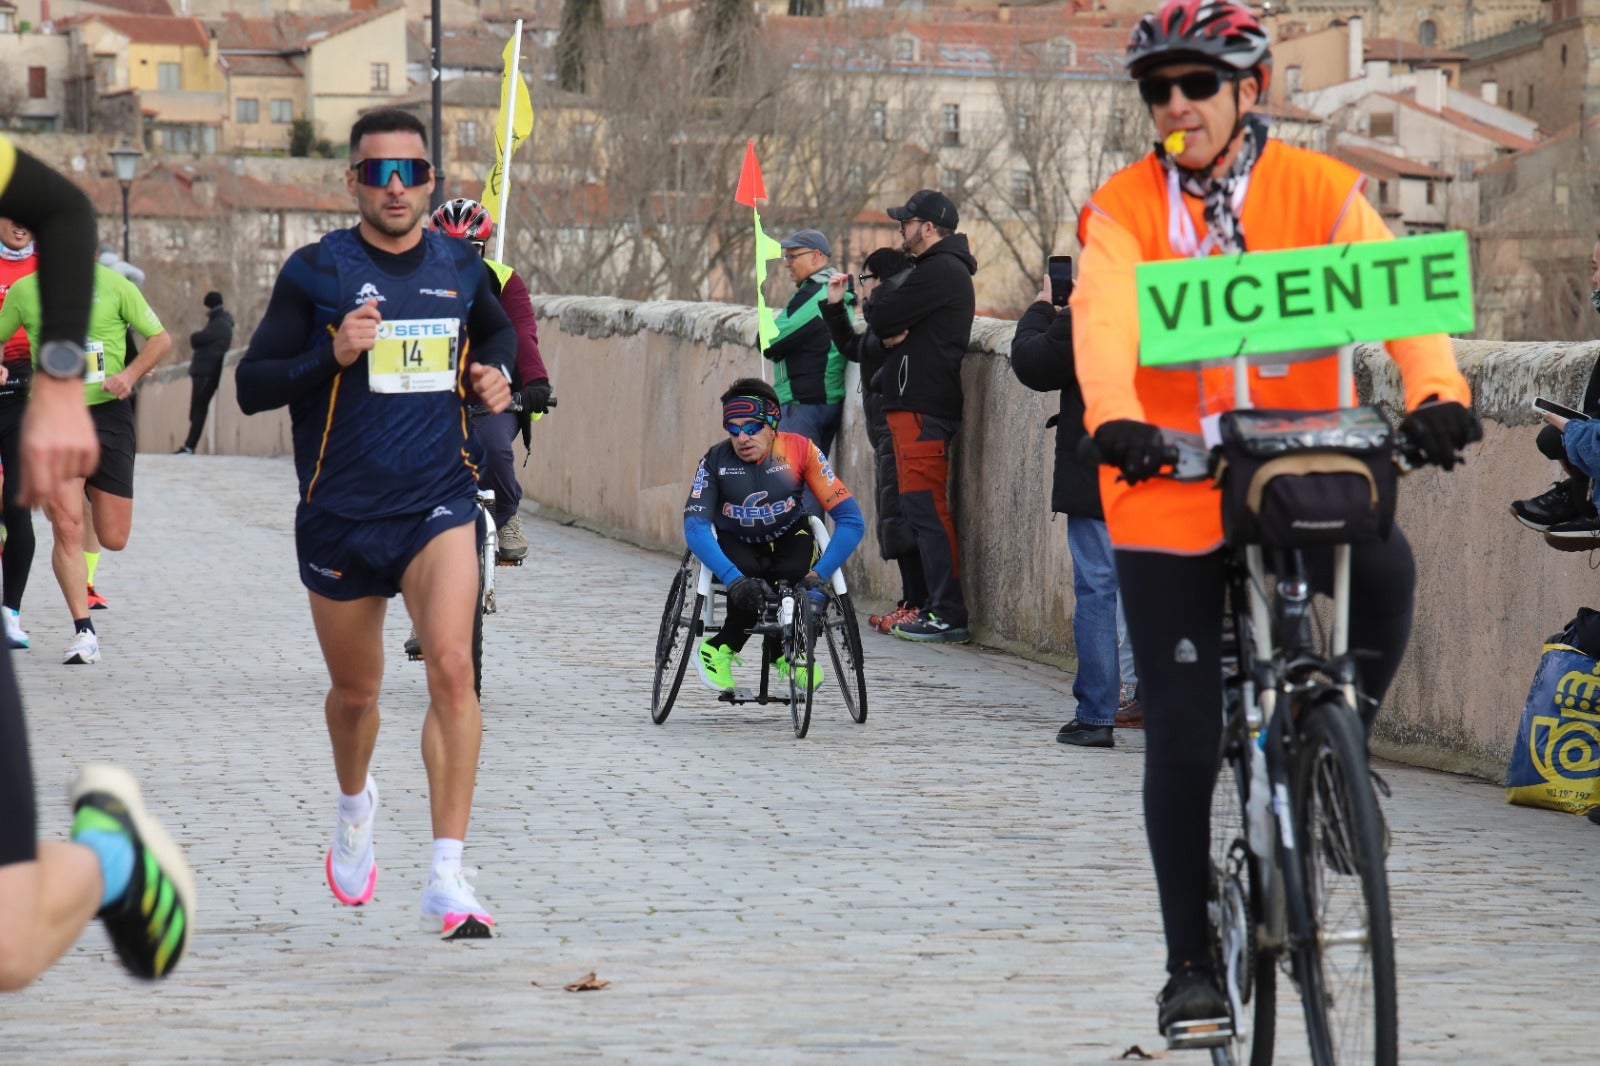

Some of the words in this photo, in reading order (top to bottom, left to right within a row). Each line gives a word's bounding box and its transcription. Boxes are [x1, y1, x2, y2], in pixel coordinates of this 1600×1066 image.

[1147, 252, 1459, 331] VICENTE
[395, 324, 450, 336] SETEL
[402, 340, 423, 367] 14
[1575, 791, 1592, 800] 197
